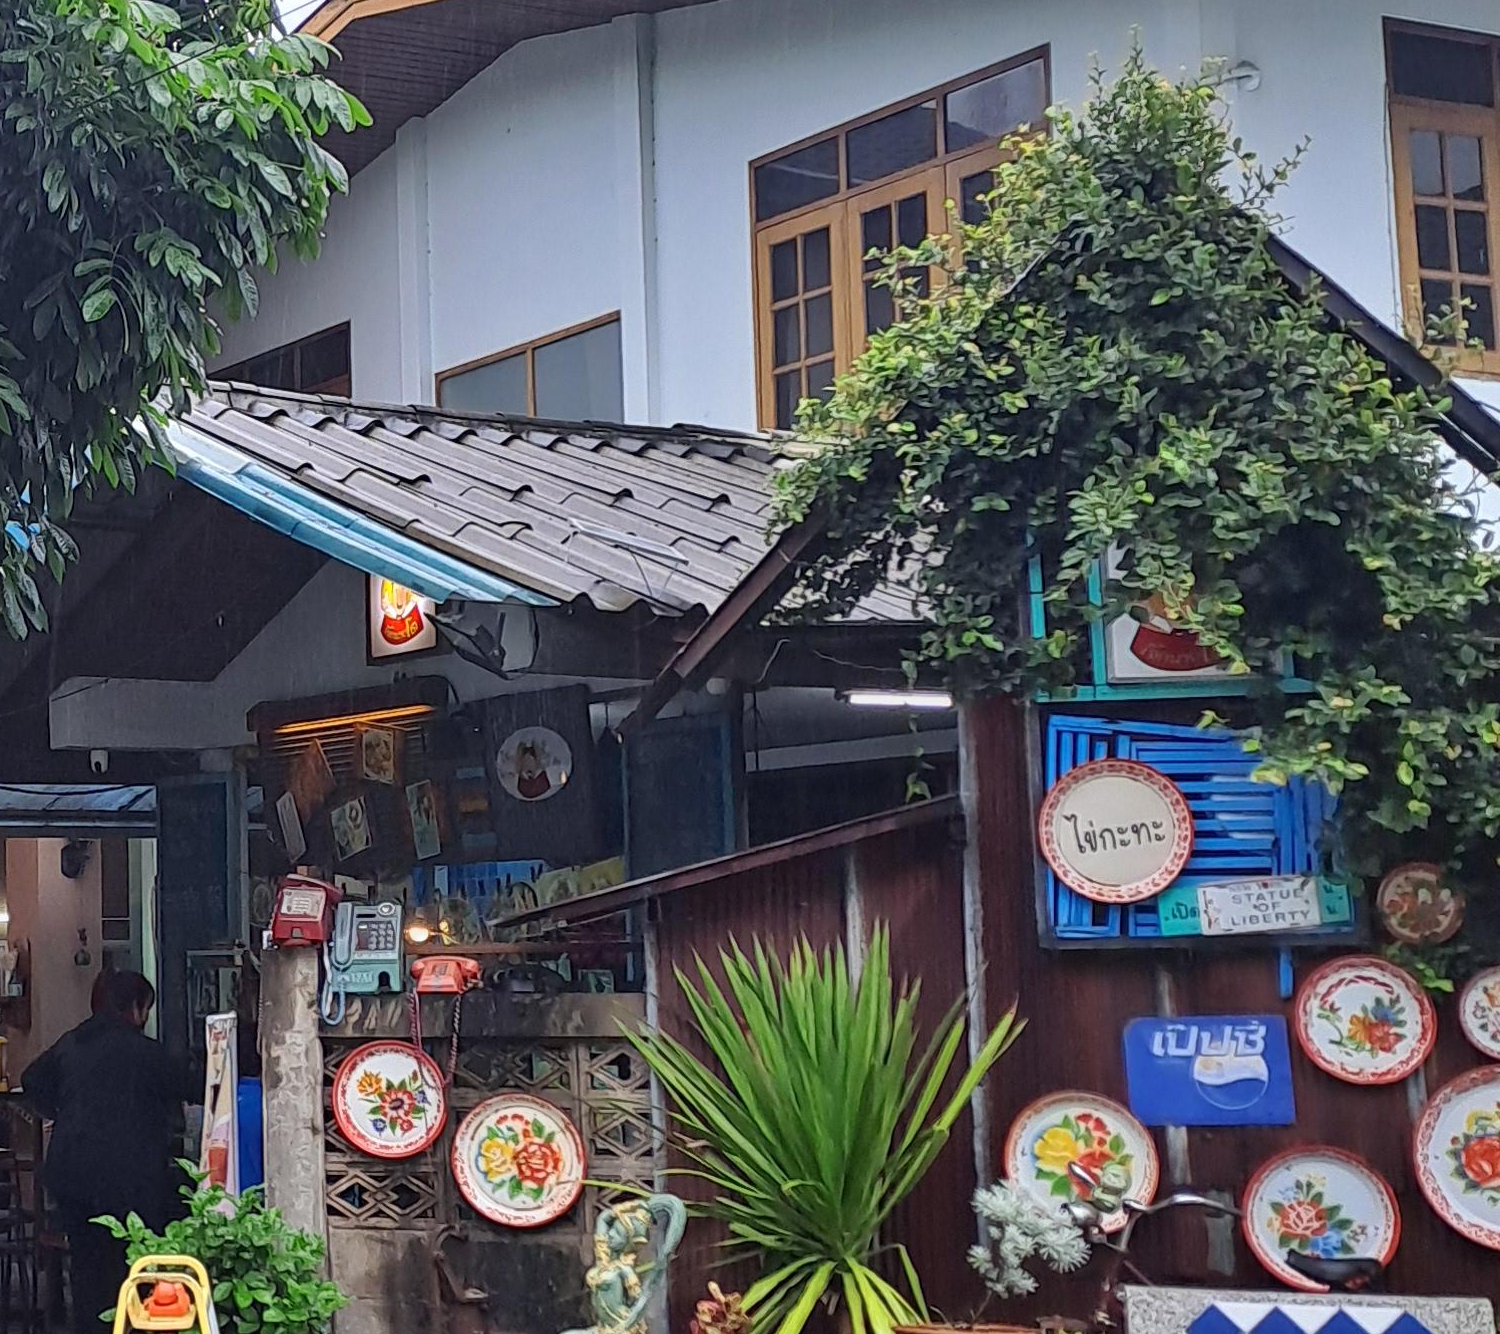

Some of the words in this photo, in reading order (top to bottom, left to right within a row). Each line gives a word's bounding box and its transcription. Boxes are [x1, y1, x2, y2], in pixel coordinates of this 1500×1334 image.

[1063, 813, 1166, 854] ไข่กะทะ
[1231, 888, 1303, 905] STATUE
[1257, 903, 1282, 913] OF
[1231, 910, 1311, 926] LIBERTY
